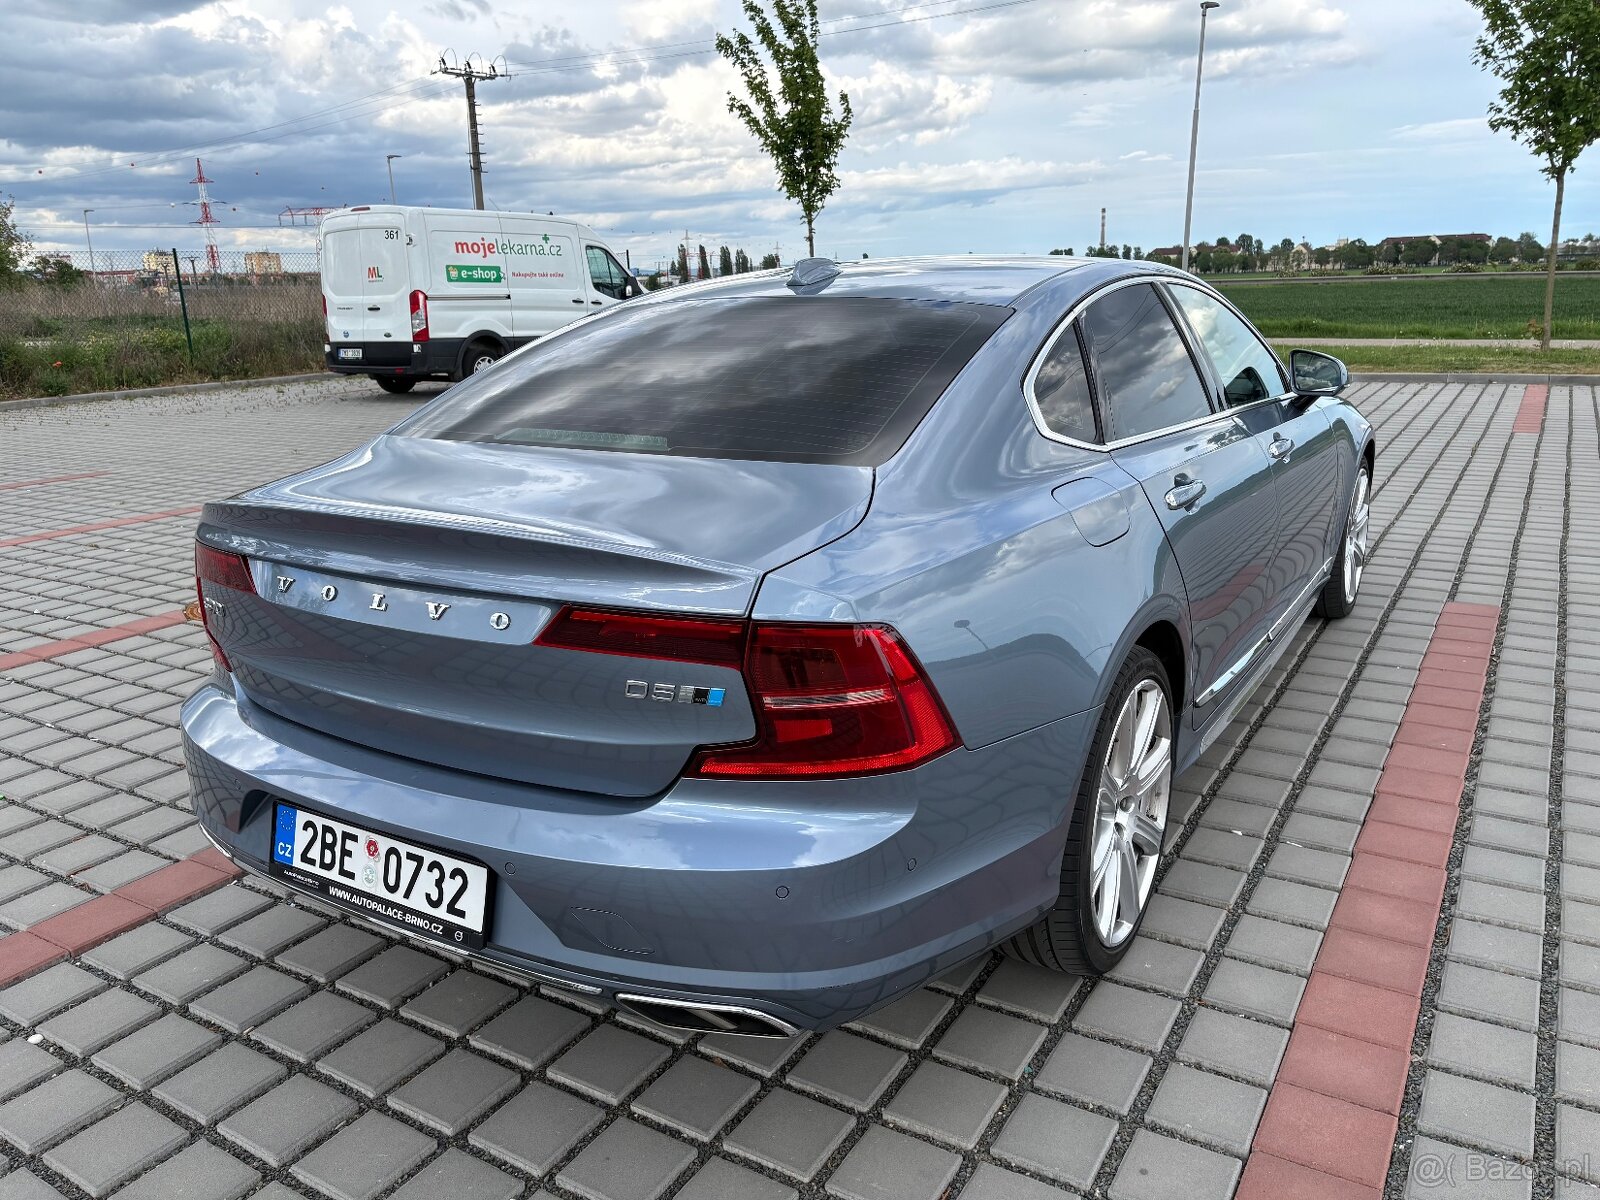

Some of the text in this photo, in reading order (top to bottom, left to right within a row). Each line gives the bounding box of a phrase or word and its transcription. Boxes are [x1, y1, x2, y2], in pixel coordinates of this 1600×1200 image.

[384, 229, 399, 240] 361
[454, 236, 562, 258] mojelekarna.cz
[461, 268, 497, 282] e-shop
[277, 575, 511, 630] VOLVO
[625, 680, 675, 702] D5
[278, 841, 292, 858] CZ
[300, 820, 469, 919] 2BE 0732
[329, 885, 443, 935] WWW.AUTOPALACE-BRNO.CZ
